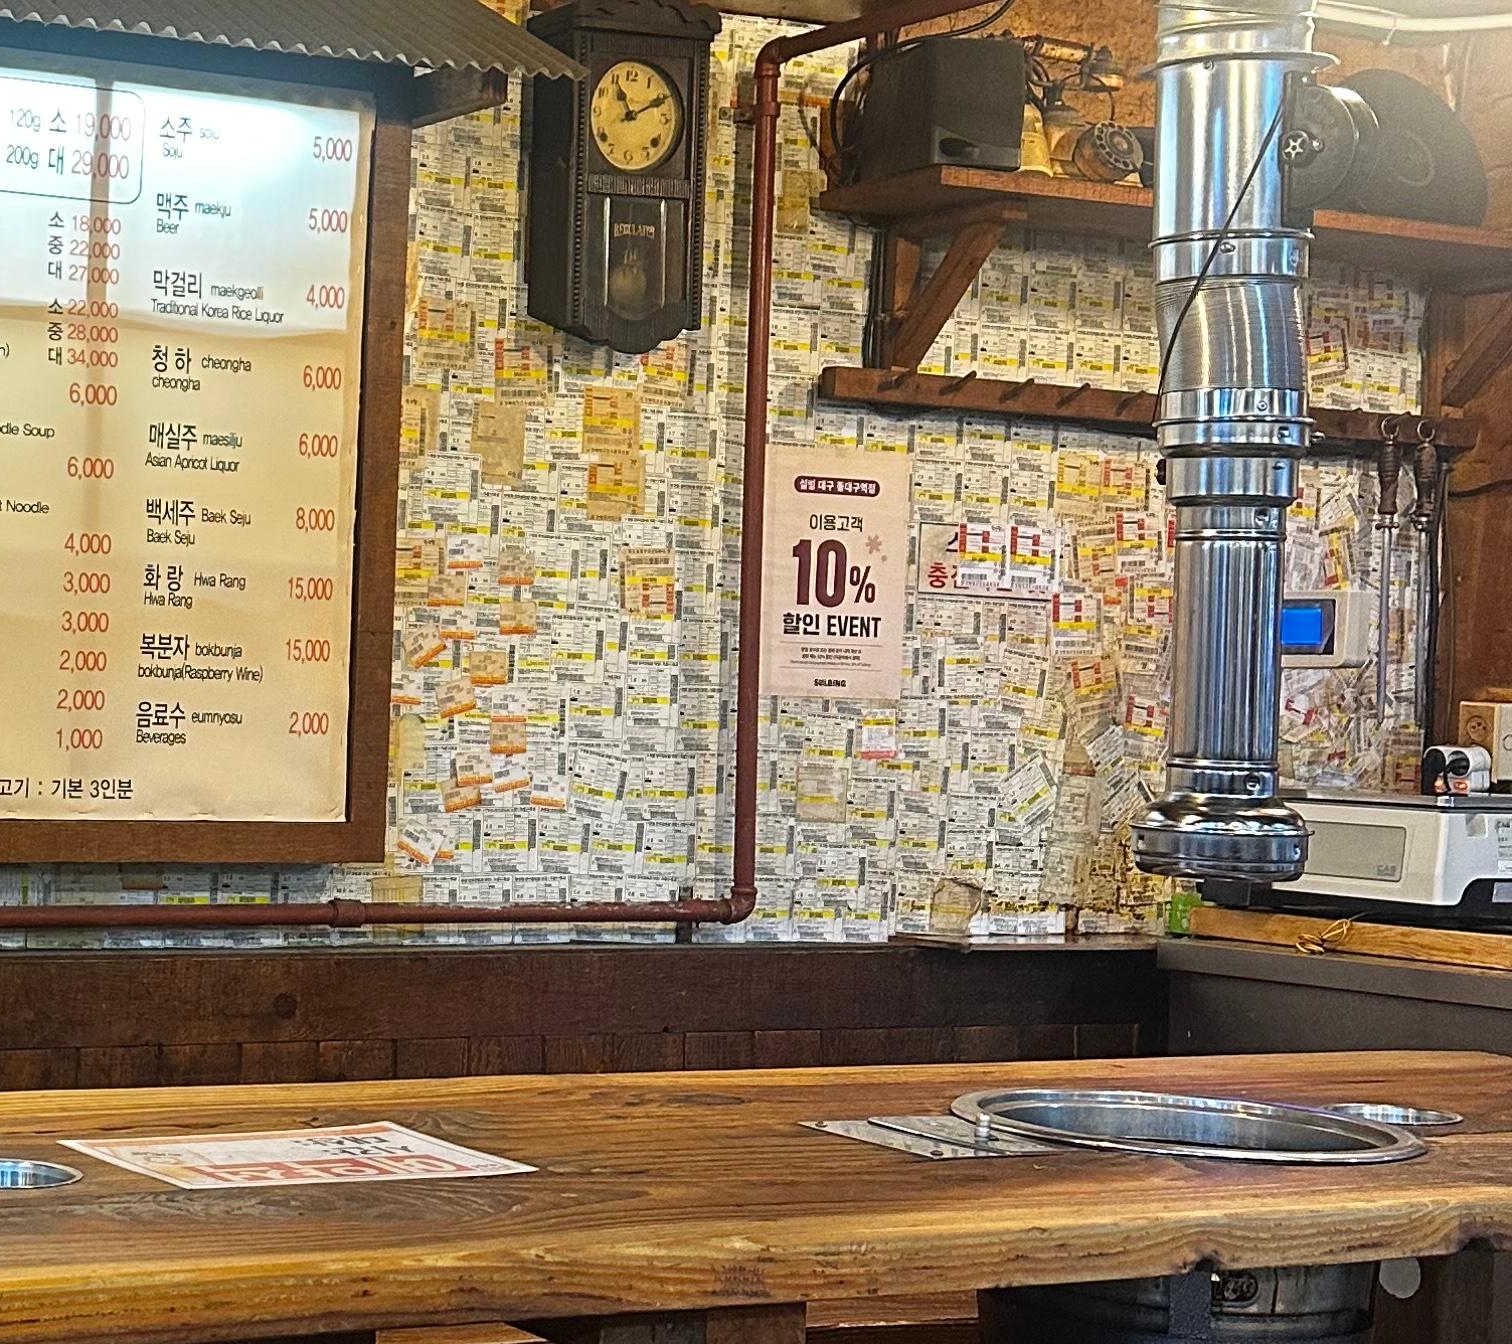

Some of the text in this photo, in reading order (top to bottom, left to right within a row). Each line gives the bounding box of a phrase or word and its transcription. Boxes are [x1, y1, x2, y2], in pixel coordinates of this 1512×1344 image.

[9, 108, 132, 142] 120g 소 19,000
[159, 116, 352, 163] 소주 5,000
[5, 144, 130, 180] 200g 대 29,000
[48, 210, 122, 236] 소 18,000
[156, 192, 348, 233] 맥주 5,000
[156, 218, 179, 234] Beer
[48, 236, 121, 261] 중 22,000
[48, 261, 120, 285] 대 27,000
[153, 269, 345, 310] 막걸리 4,000
[48, 297, 119, 320] 소 22,000
[150, 297, 284, 325] Traditional Korea Rice Liquor
[48, 321, 119, 344] 중 28,000
[48, 347, 119, 368] 대 34,000
[151, 375, 201, 393] cheongha
[201, 354, 341, 391] cheongha 6,000
[69, 382, 118, 407] 6,000
[22, 423, 55, 440] Soup
[149, 422, 338, 460] 매실주 6,000
[67, 456, 114, 481] 6,000
[145, 451, 240, 474] Asian Apricot Liquor
[817, 480, 834, 492] 대구
[6, 499, 50, 515] Noodle
[146, 498, 335, 533] 백세주 Baek Seju 8,000
[809, 514, 864, 533] 이용고객
[64, 532, 112, 557] 4,000
[146, 528, 195, 547] Baek Seju
[63, 570, 111, 595] 3,000
[792, 538, 877, 608] 10%
[194, 571, 333, 602] Hwa Rang 15,000
[144, 592, 192, 609] Hwa Rang
[61, 610, 109, 635] 3,000
[782, 612, 882, 638] 할인 EVENT
[140, 633, 331, 664] 복분자 bokbunja 15,000
[59, 649, 107, 674] 2,000
[56, 688, 105, 713] 2,000
[136, 701, 329, 737] 음료수 2,000
[56, 727, 103, 752] 1,000
[136, 729, 186, 746] Beverages
[51, 778, 84, 799] 기본
[89, 779, 134, 800] 3인분
